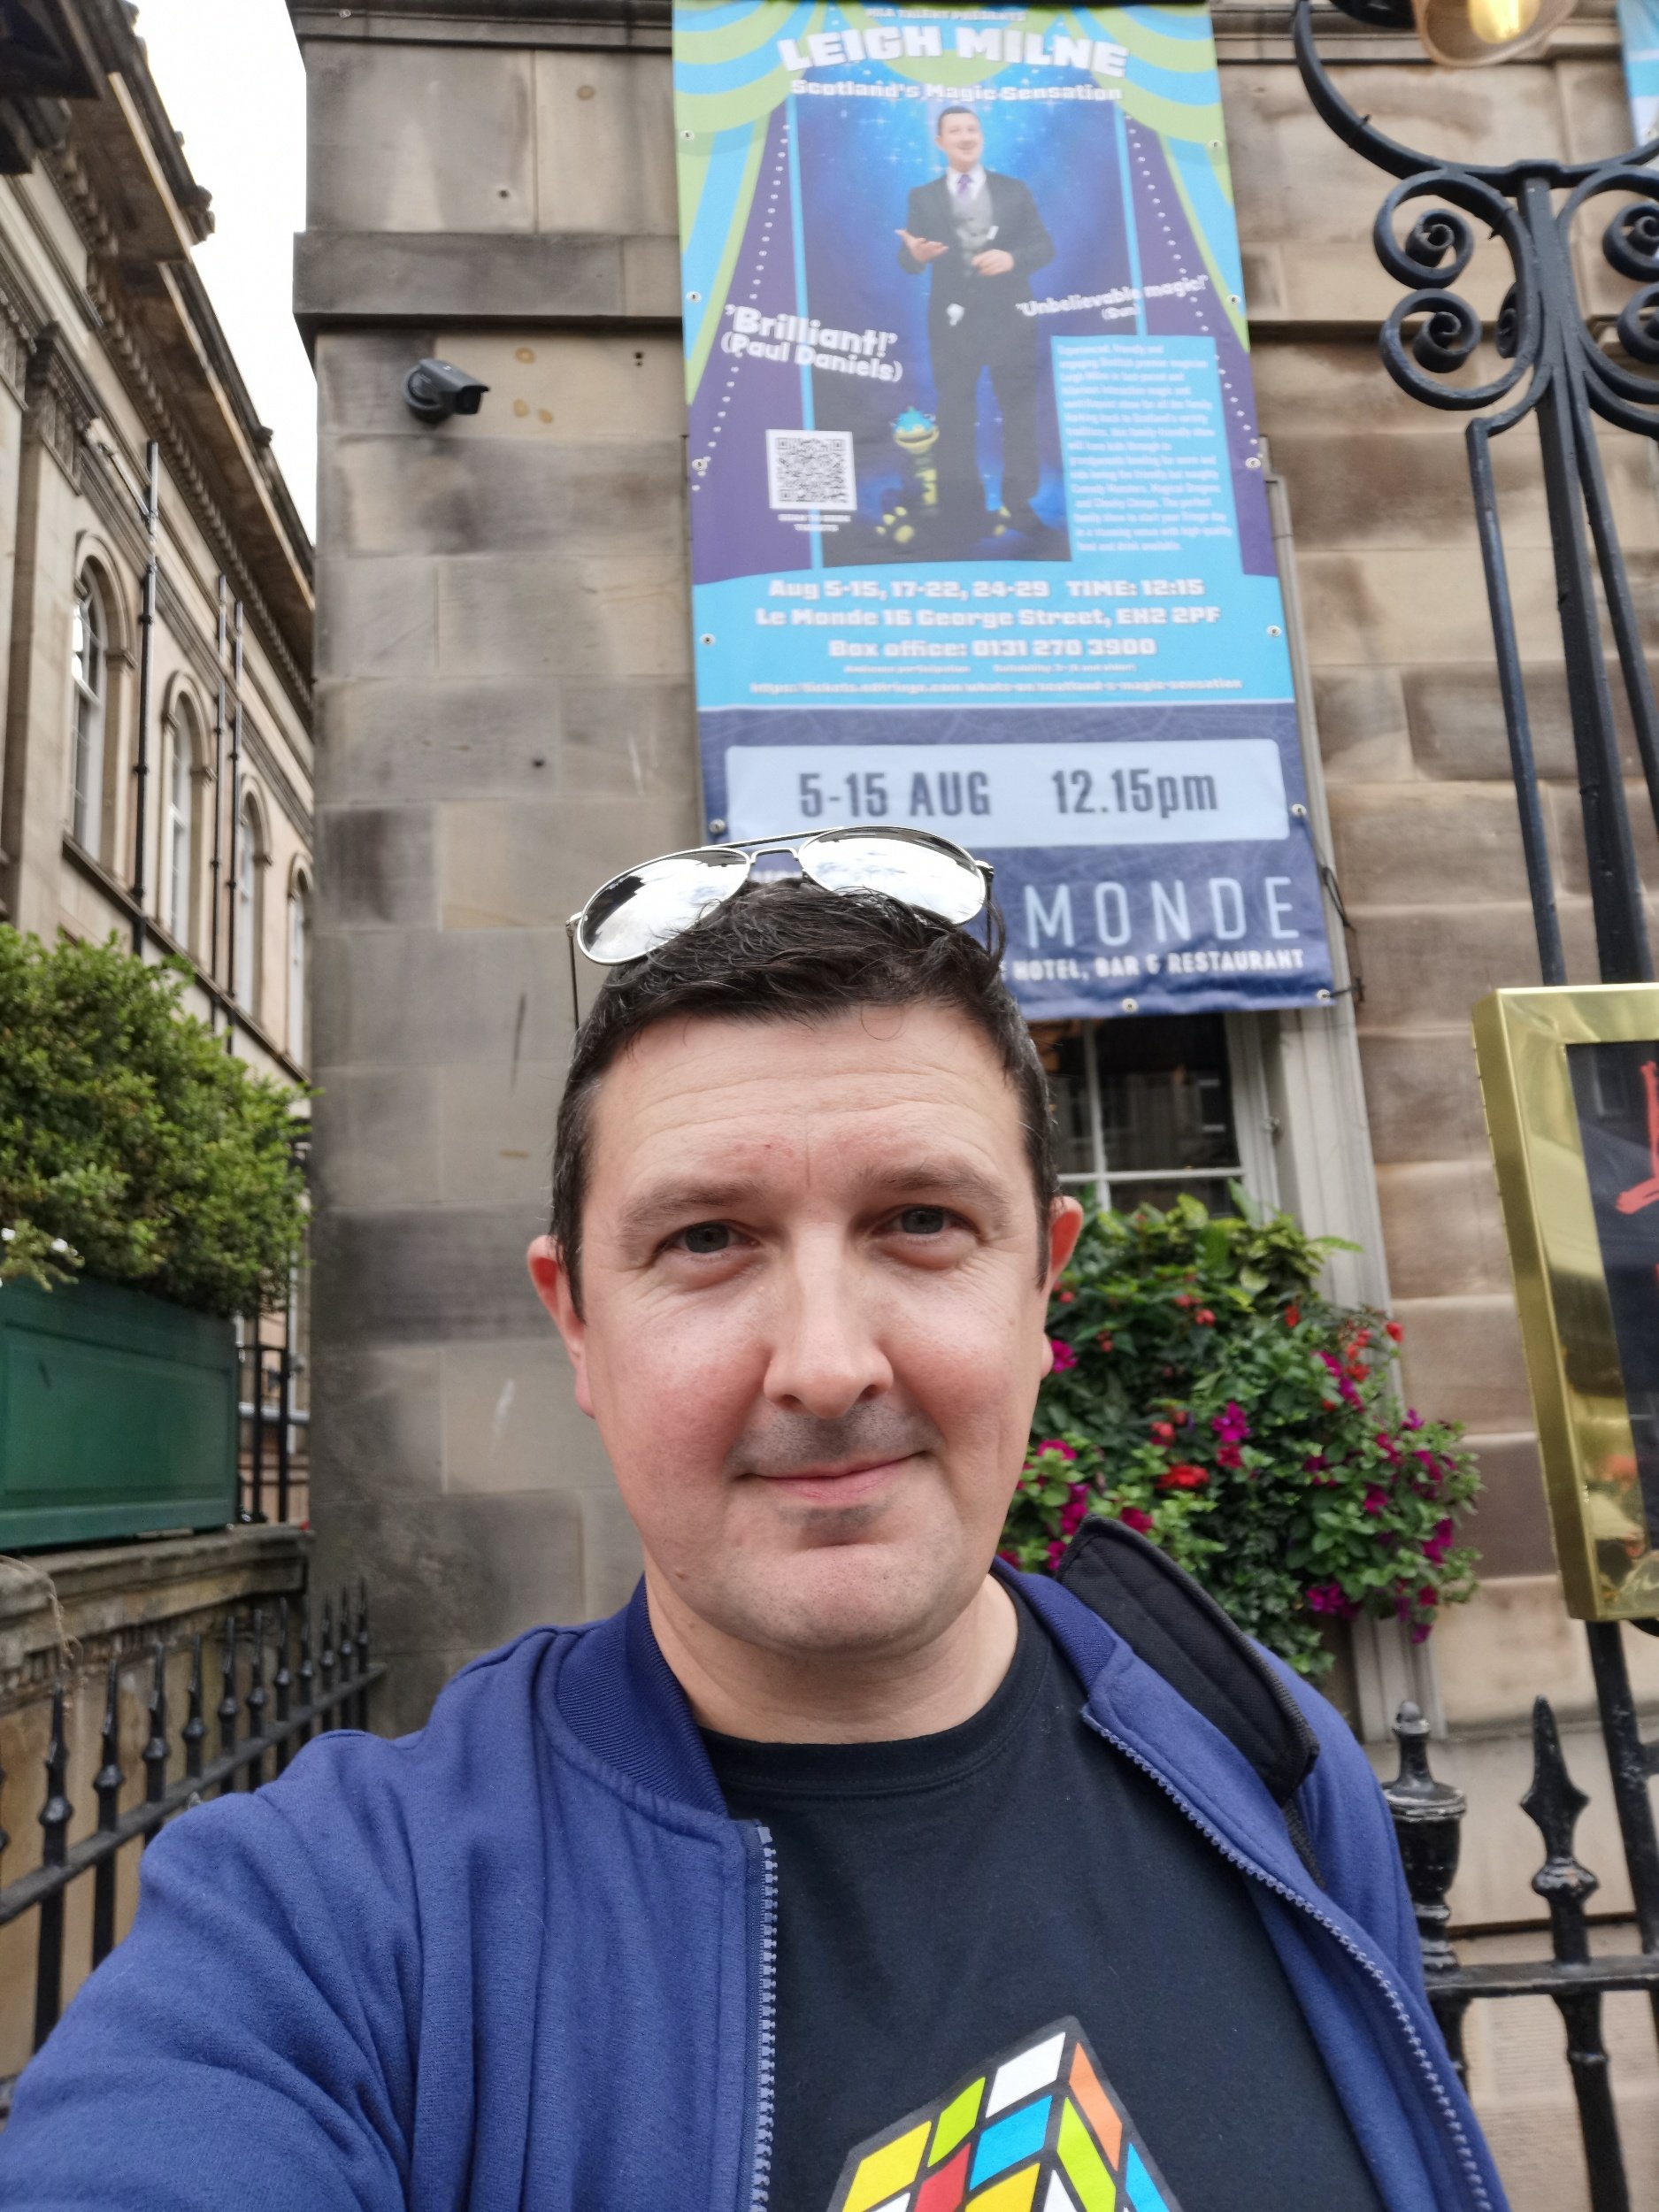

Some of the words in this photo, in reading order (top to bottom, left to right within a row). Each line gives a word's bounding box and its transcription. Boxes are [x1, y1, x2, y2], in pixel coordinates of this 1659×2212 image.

[777, 26, 943, 71] LEIGH
[955, 27, 1129, 78] MILNE
[790, 79, 921, 99] Scotland's
[926, 83, 996, 102] Magic
[999, 84, 1122, 101] Sensation
[721, 331, 791, 363] (Paul
[795, 344, 903, 382] Daniels)
[768, 580, 820, 601] Aug
[824, 580, 888, 601] 5-15,
[890, 580, 969, 602] 17-22,
[972, 580, 1050, 598] 24-29
[1065, 580, 1139, 597] TIME:
[1141, 579, 1205, 596] 12:15
[755, 608, 787, 626] Le
[791, 608, 879, 626] Monde
[882, 609, 912, 626] 16
[916, 609, 1015, 629] George
[1018, 609, 1112, 629] Street,
[1116, 608, 1168, 625] EH2
[1171, 606, 1220, 624] 2PF
[828, 640, 879, 657] Box
[884, 639, 968, 657] office:
[972, 639, 1028, 657] 0131
[1033, 639, 1084, 657] 270
[1087, 638, 1157, 656] 3900
[798, 772, 889, 818] 5-15
[908, 771, 991, 818] AUG
[1051, 768, 1218, 819] 12.15pm
[1024, 876, 1301, 949] MONDE
[1012, 958, 1090, 983] HOTEL,
[1094, 956, 1141, 979] BAR
[1168, 949, 1305, 975] RESTAURANT
